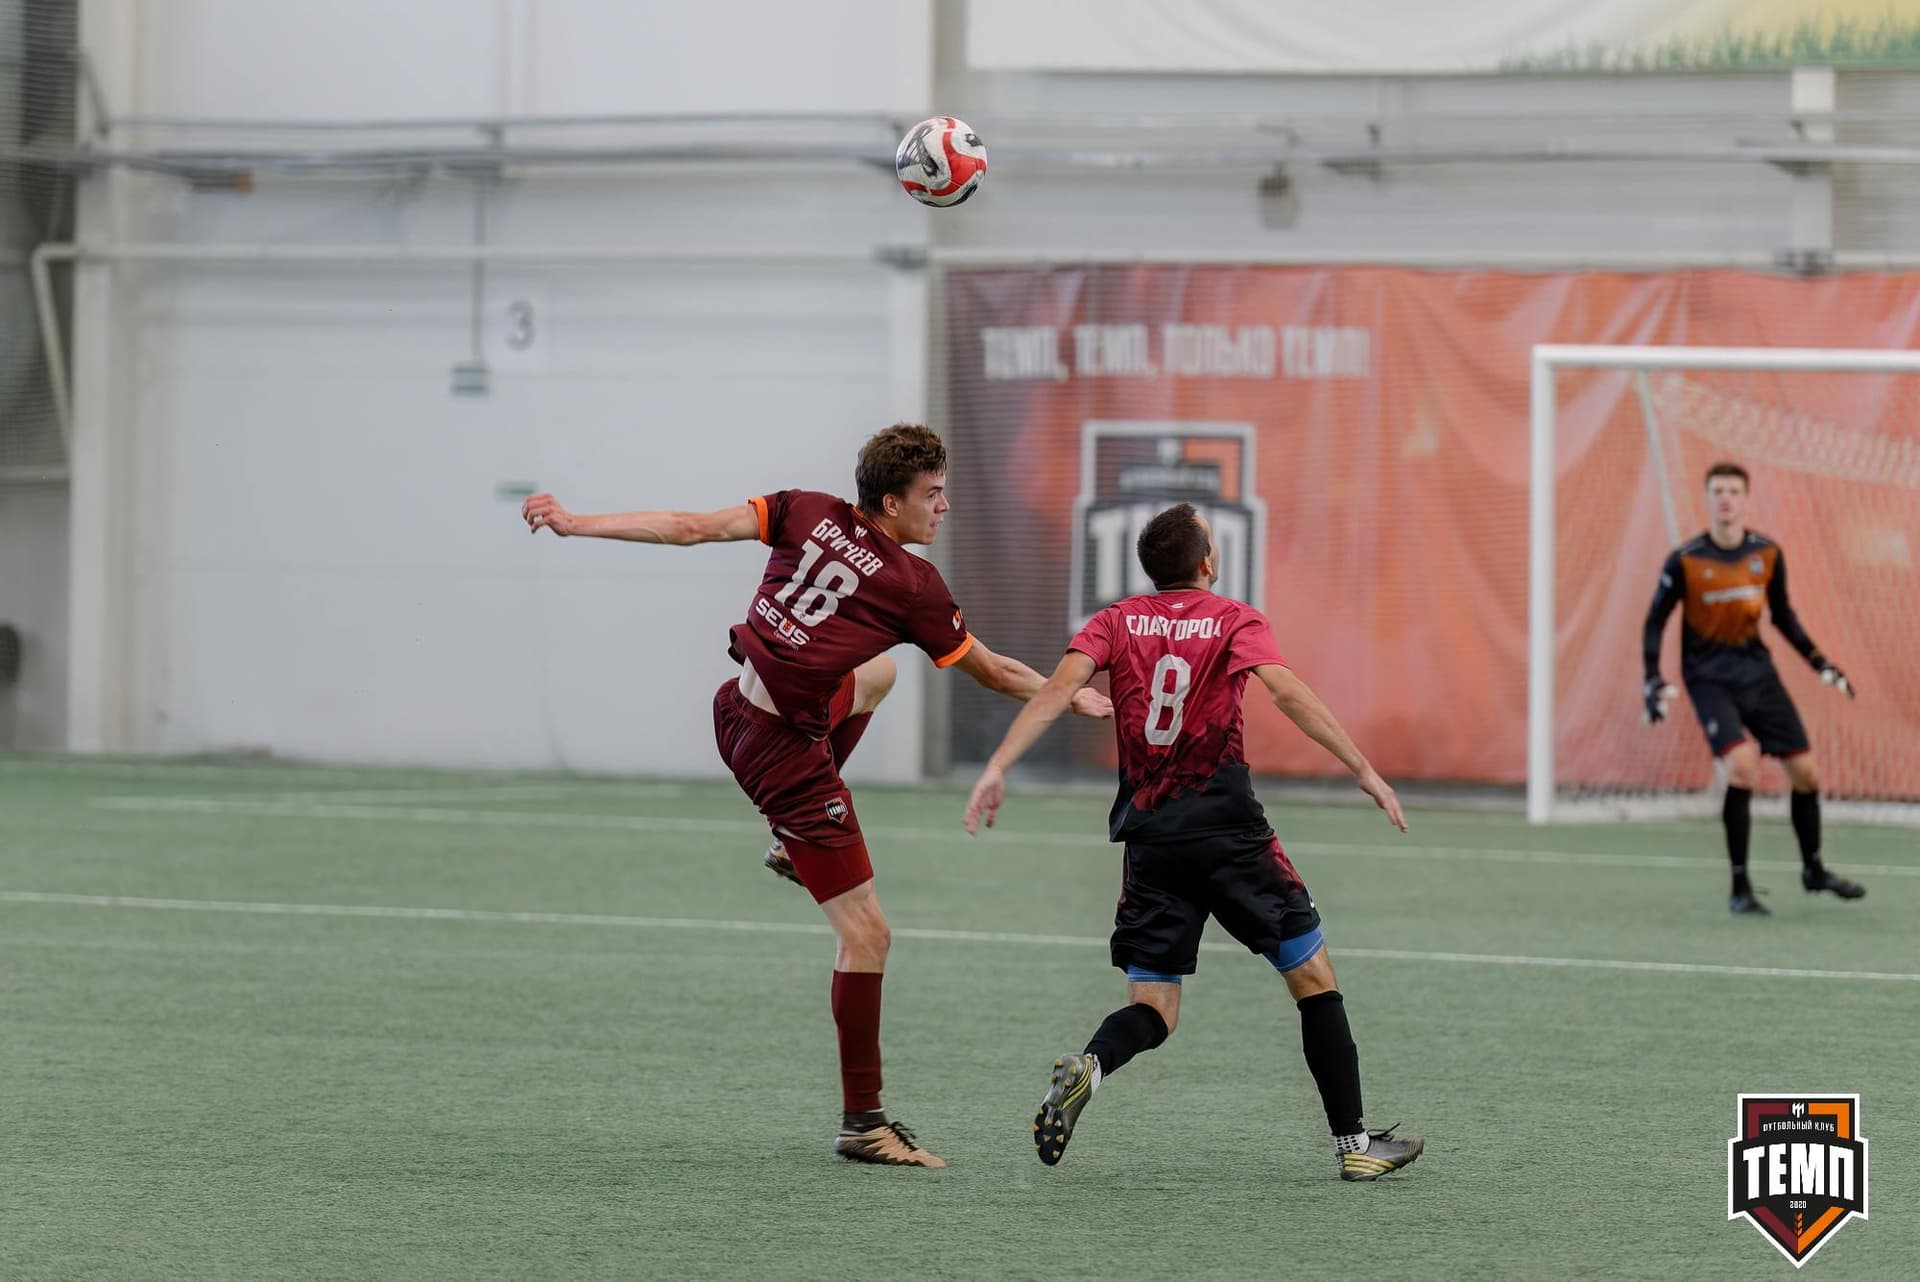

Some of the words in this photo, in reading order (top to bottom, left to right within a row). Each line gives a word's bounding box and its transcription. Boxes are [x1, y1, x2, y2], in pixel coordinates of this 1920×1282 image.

[504, 299, 536, 352] 3
[811, 518, 884, 576] БРИЧЕЕВ
[774, 539, 860, 627] 18
[755, 598, 810, 646] SEUS
[1144, 654, 1191, 746] 8
